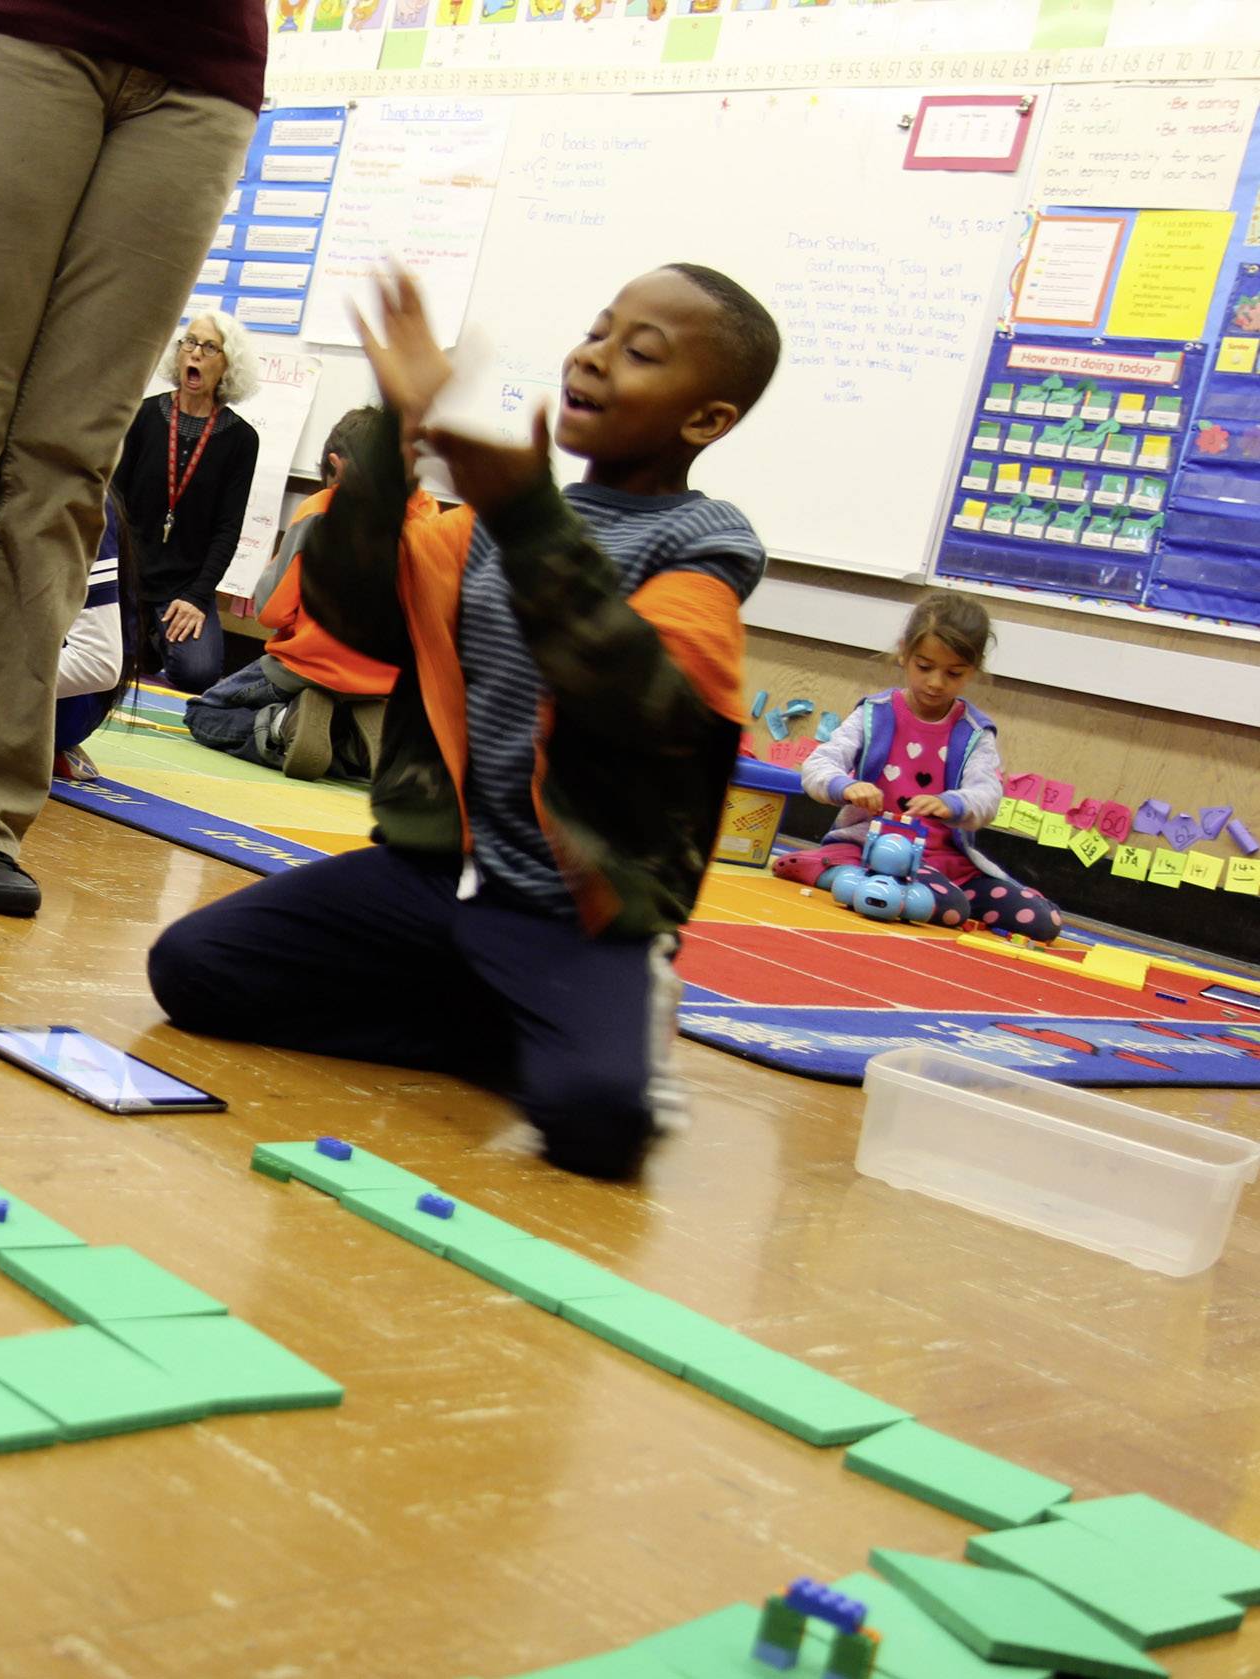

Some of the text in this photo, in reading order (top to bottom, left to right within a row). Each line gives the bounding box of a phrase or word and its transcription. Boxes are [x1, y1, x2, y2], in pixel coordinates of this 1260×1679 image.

[826, 62, 842, 79] 54
[846, 62, 861, 79] 55
[868, 61, 881, 79] 56
[887, 60, 902, 78] 57
[905, 60, 923, 78] 58
[929, 60, 945, 78] 59
[950, 60, 967, 78] 60
[973, 60, 986, 78] 61
[990, 59, 1007, 78] 62
[1013, 58, 1029, 77] 63
[1035, 58, 1051, 77] 64
[1056, 56, 1072, 74] 65
[1079, 55, 1094, 73] 66
[1101, 53, 1118, 72] 67
[1122, 53, 1141, 72] 68
[1146, 52, 1166, 71] 69
[1175, 52, 1193, 71] 70
[1203, 51, 1217, 70] 71
[1224, 50, 1244, 70] 72
[1170, 96, 1240, 116] Be caring
[1160, 119, 1245, 137] Be respectful
[562, 131, 597, 152] books
[786, 231, 821, 249] Dear
[927, 215, 952, 240] May
[266, 357, 307, 384] Marks
[1021, 352, 1048, 364] How
[1051, 355, 1071, 366] am
[1080, 357, 1115, 375] doing
[1118, 362, 1161, 377] today?
[1101, 810, 1126, 835] 60
